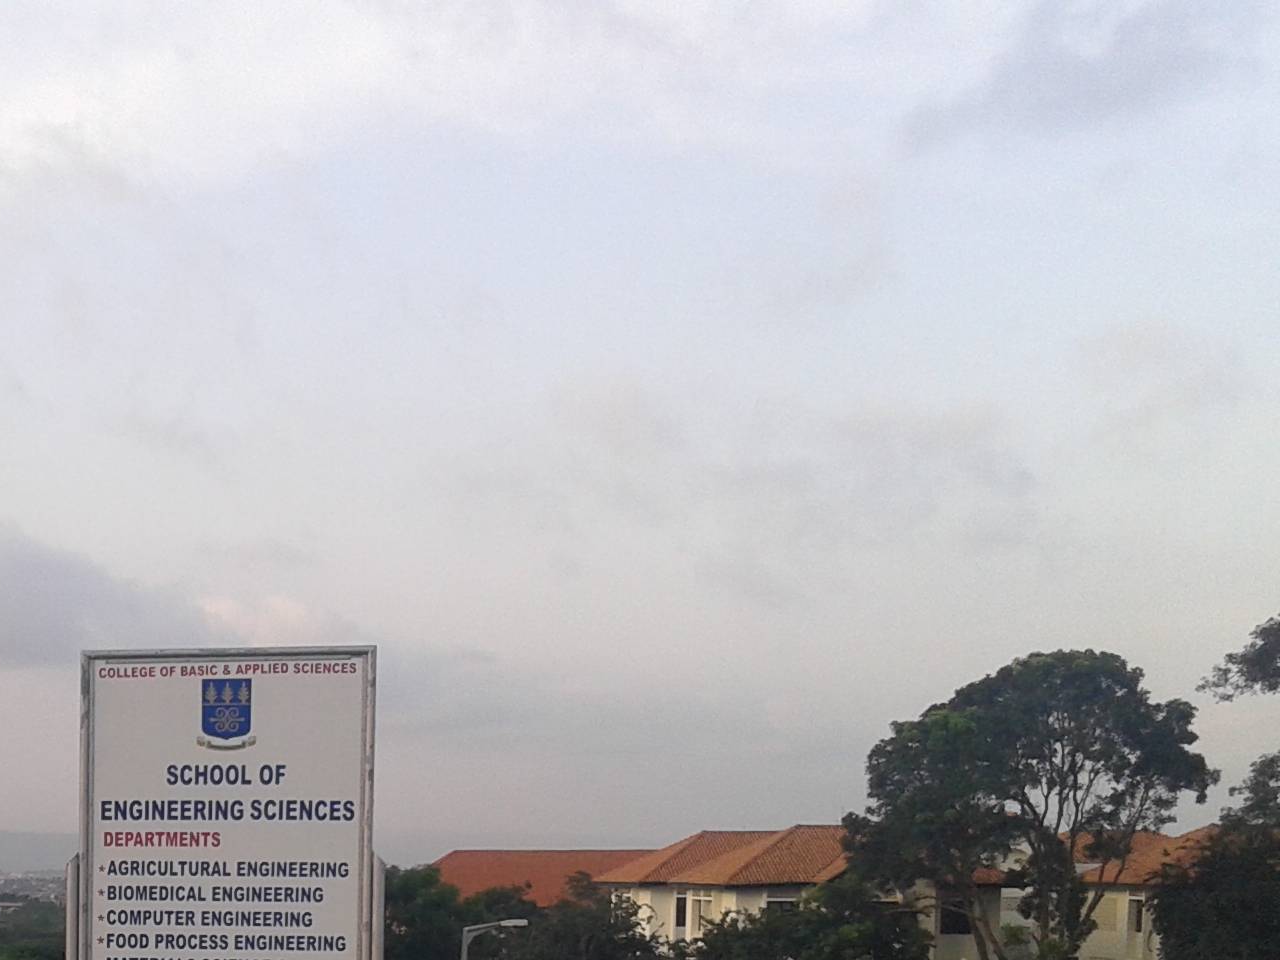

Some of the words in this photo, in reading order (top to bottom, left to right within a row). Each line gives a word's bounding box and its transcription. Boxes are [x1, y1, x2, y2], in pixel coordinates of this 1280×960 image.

[98, 667, 156, 678] COLLEGE
[160, 666, 176, 676] OF
[180, 665, 218, 676] BASIC
[222, 664, 230, 675] &
[236, 664, 289, 674] APPLIED
[293, 663, 357, 674] SCIENCES
[166, 765, 252, 785] SCHOOL
[259, 765, 286, 785] OF
[100, 800, 244, 820] ENGINEERING
[250, 800, 355, 821] SCIENCES
[104, 832, 221, 848] DEPARTMENTS
[107, 861, 231, 877] AGRICULTURAL
[236, 862, 349, 878] ENGINEERING
[107, 886, 206, 901] BIOMEDICAL
[212, 887, 324, 902] ENGINEERING
[106, 910, 195, 926] COMPUTER
[201, 911, 313, 927] ENGINEERING
[106, 934, 149, 949] FOOD
[154, 934, 228, 950] PROCESS
[234, 935, 346, 951] ENGINEERING
